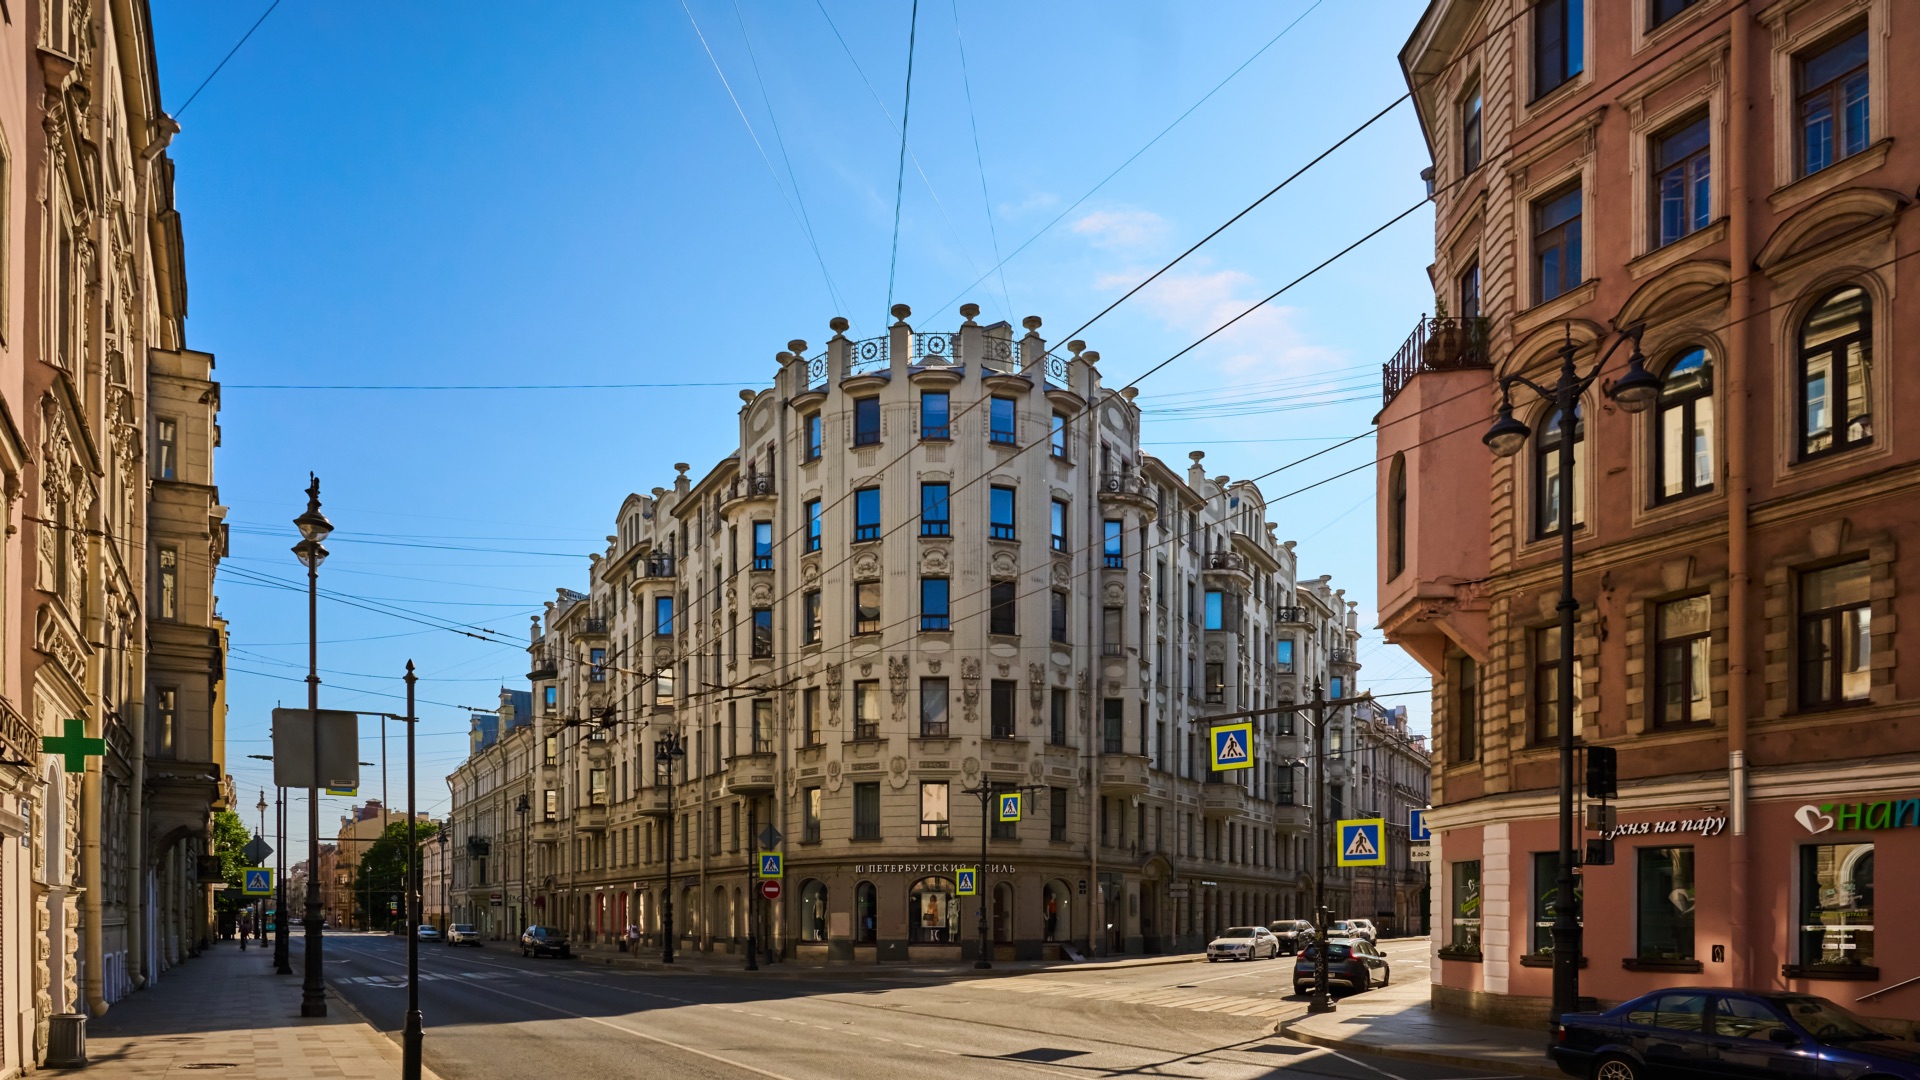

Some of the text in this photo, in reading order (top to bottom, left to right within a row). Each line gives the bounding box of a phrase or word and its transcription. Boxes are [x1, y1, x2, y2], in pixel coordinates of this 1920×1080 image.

[1599, 815, 1727, 841] ухня на пару
